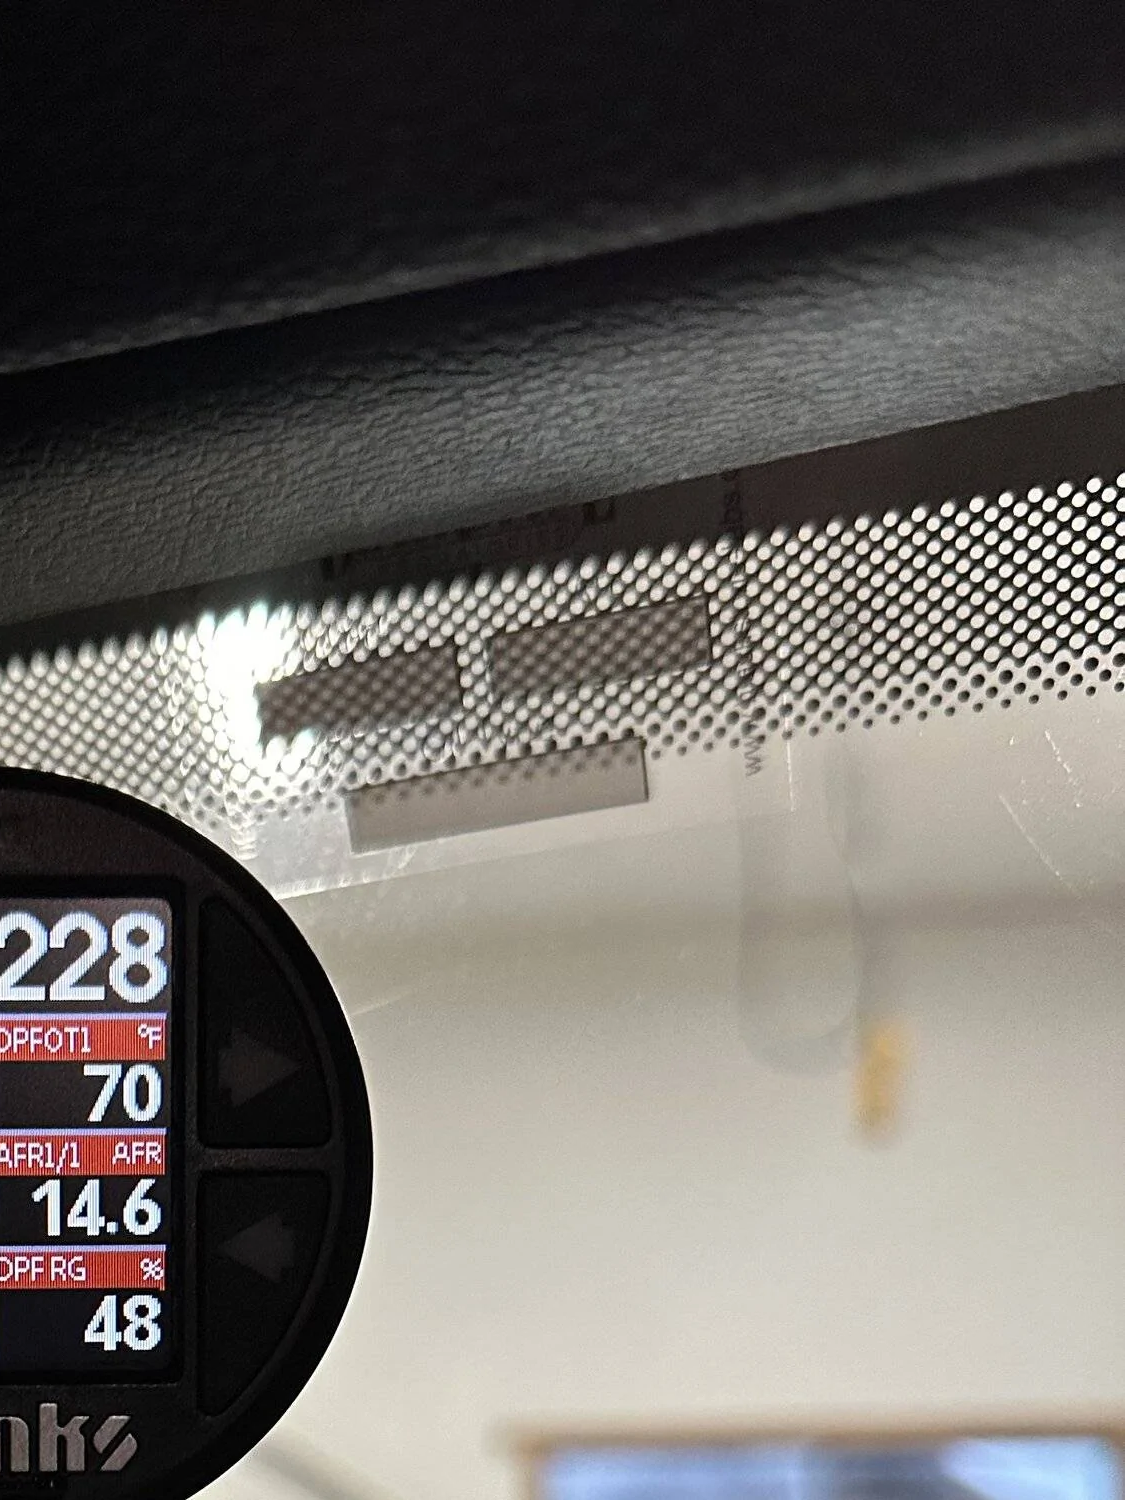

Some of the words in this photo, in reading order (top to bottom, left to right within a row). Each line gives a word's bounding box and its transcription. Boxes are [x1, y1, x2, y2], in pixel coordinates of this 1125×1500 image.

[83, 1064, 162, 1123] 70
[112, 1142, 162, 1165] AFR
[31, 1179, 162, 1236] 14.6
[50, 1256, 87, 1282] RG
[140, 1257, 164, 1281] %
[84, 1294, 162, 1352] 48
